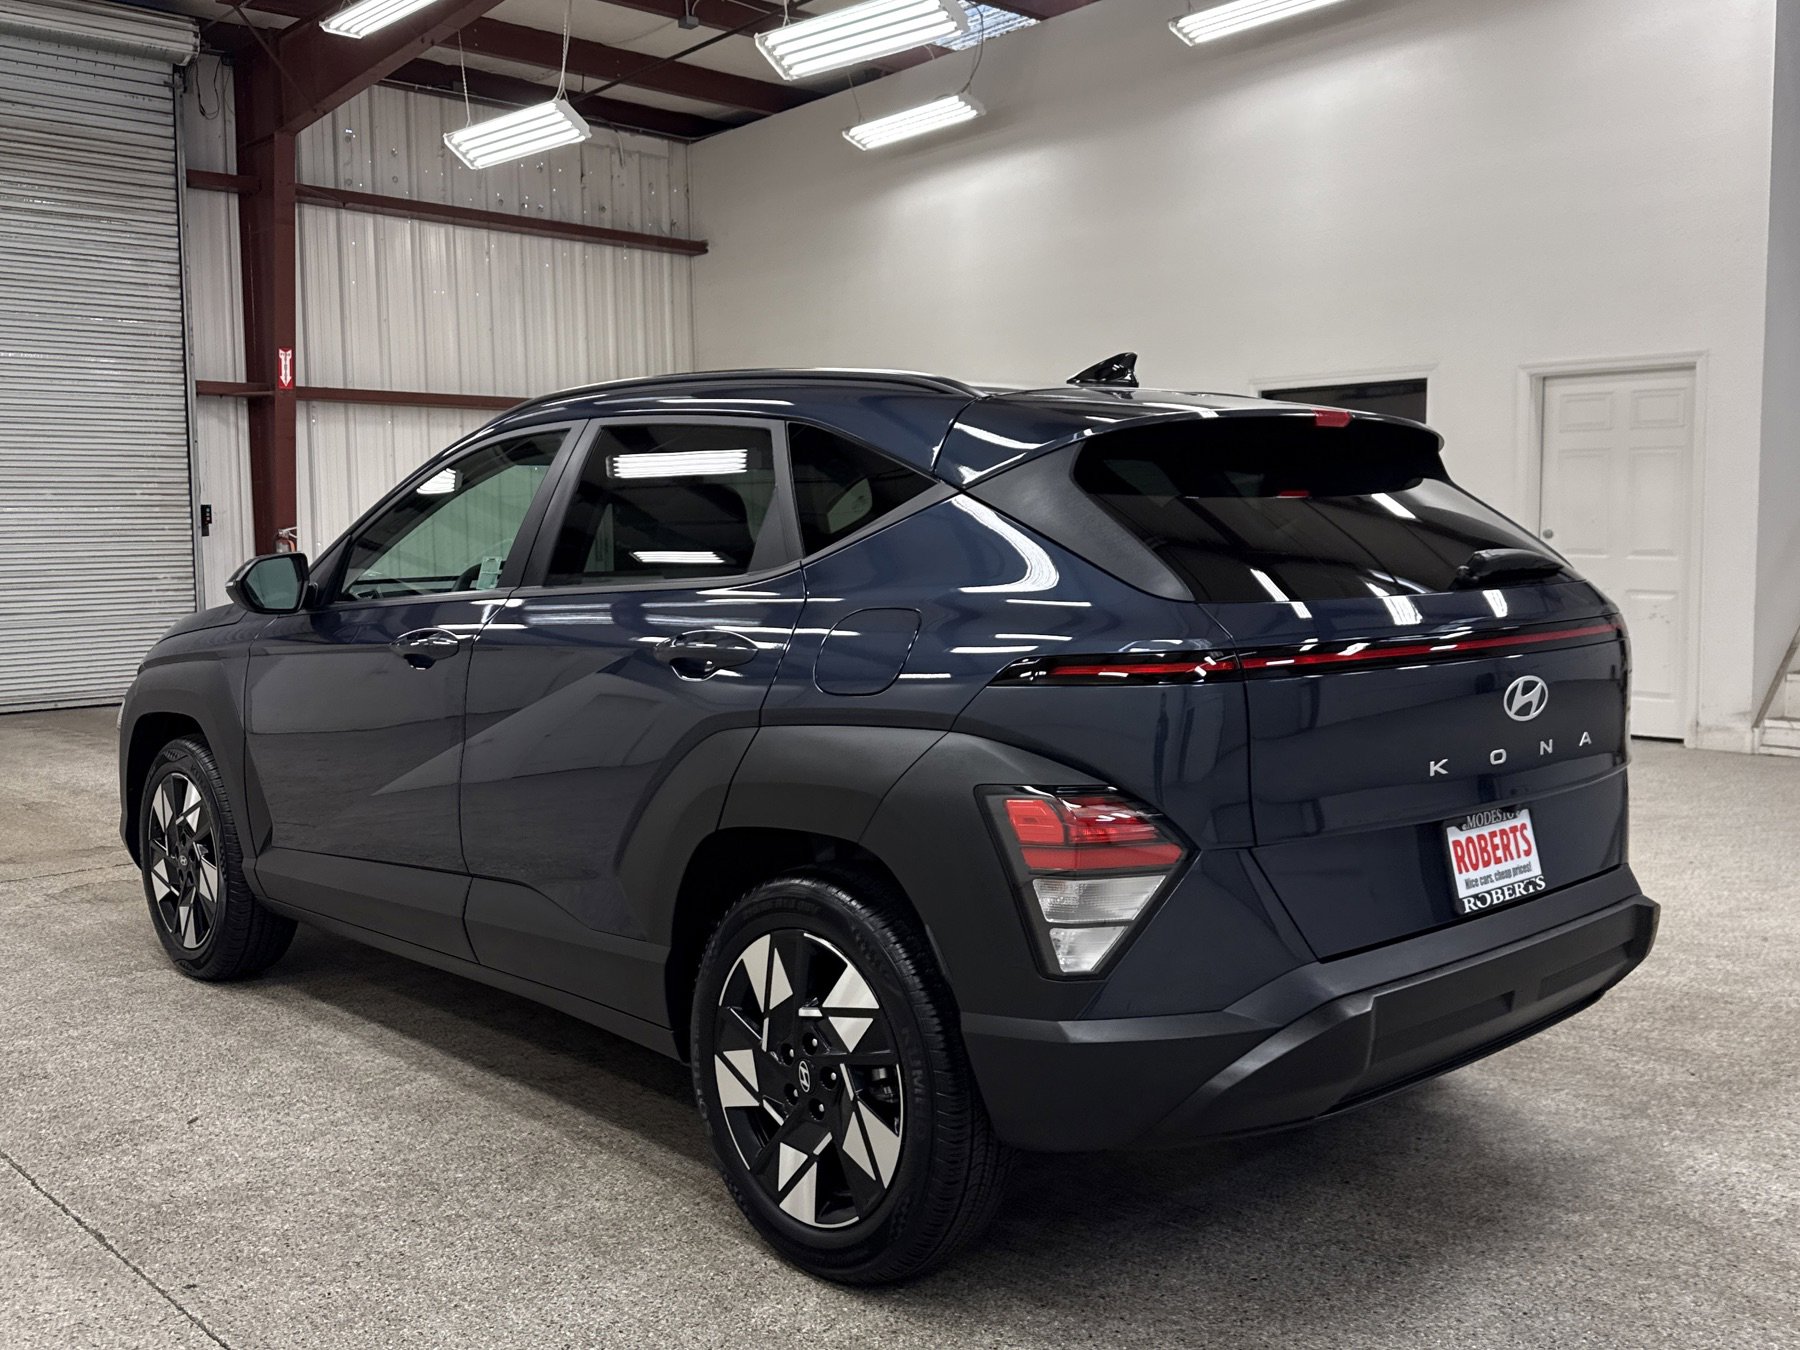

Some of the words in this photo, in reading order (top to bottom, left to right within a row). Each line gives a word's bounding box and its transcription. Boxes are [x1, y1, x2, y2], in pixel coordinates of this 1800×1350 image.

[1430, 731, 1592, 776] KONA
[1452, 823, 1532, 874] ROBERTS
[1462, 876, 1546, 913] ROBERTS
[1465, 877, 1479, 889] Nice
[1494, 870, 1512, 881] cheap
